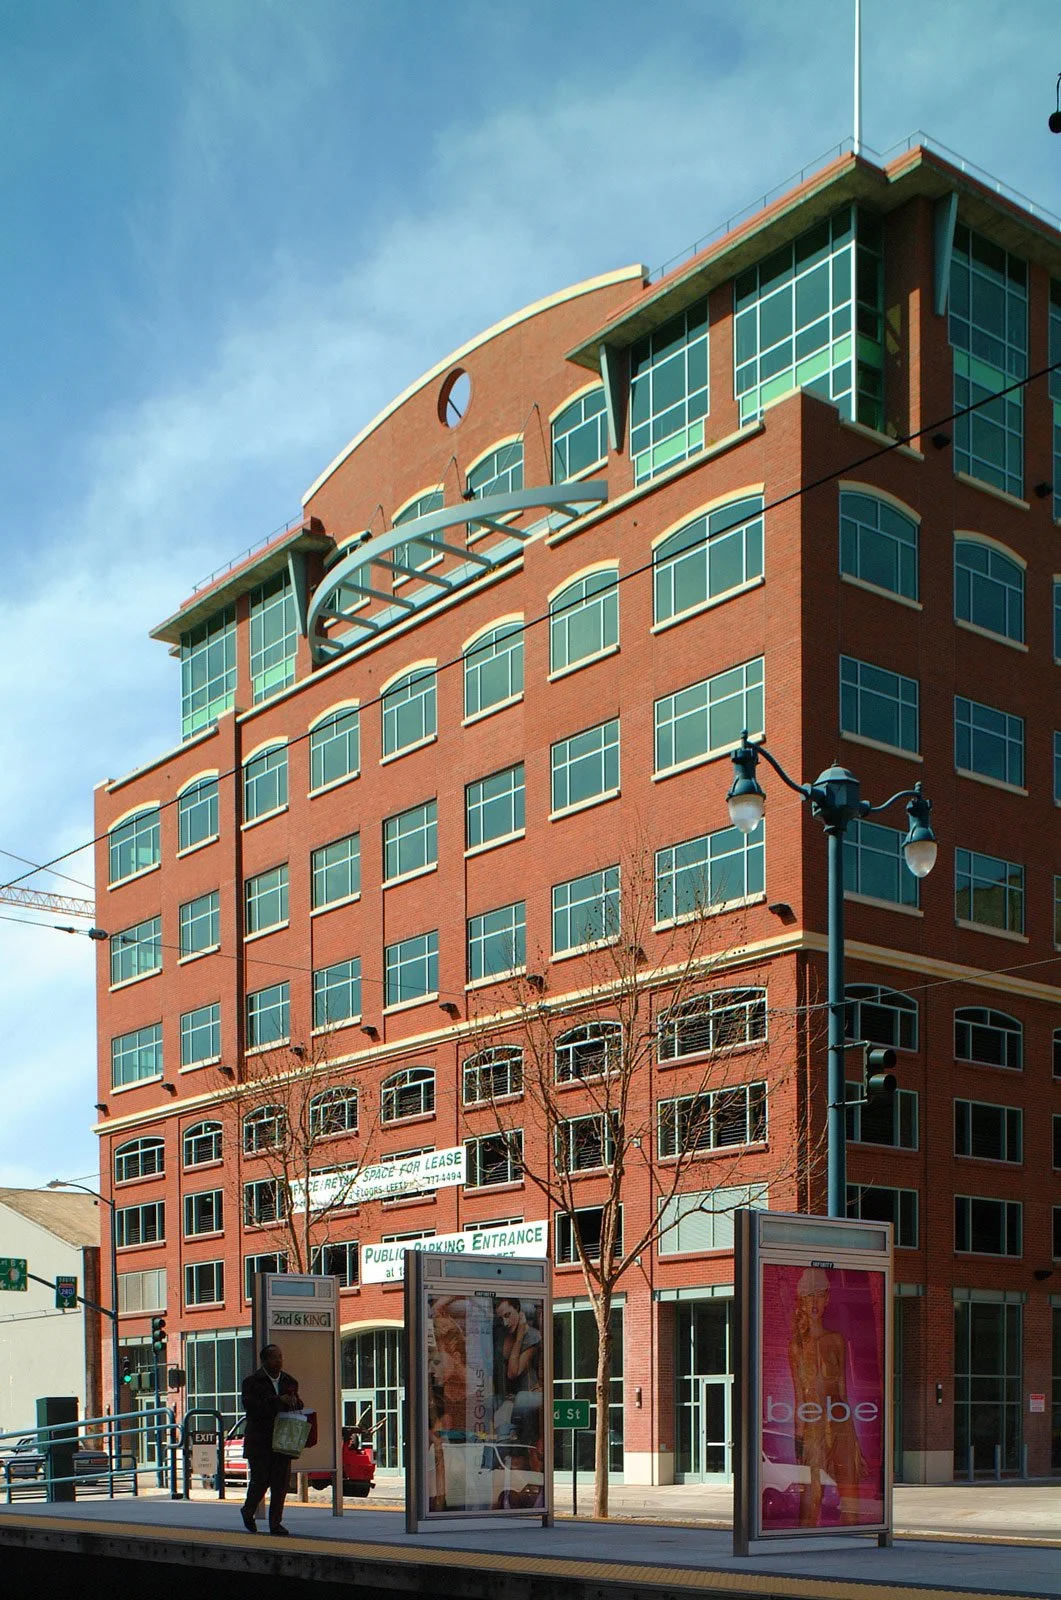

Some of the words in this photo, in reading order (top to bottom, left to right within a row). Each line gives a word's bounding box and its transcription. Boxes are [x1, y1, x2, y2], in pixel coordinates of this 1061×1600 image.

[363, 1165, 394, 1183] SPACE
[400, 1160, 420, 1176] FOR
[426, 1151, 462, 1170] LEASE
[365, 1247, 405, 1264] PUBLIC
[414, 1238, 465, 1253] PARKING
[472, 1227, 543, 1251] ENTRANCE
[273, 1313, 292, 1325] 2nd
[294, 1313, 301, 1326] &
[303, 1314, 327, 1326] KING
[566, 1408, 581, 1420] St
[767, 1395, 879, 1423] bebe
[195, 1433, 215, 1442] EXIT
